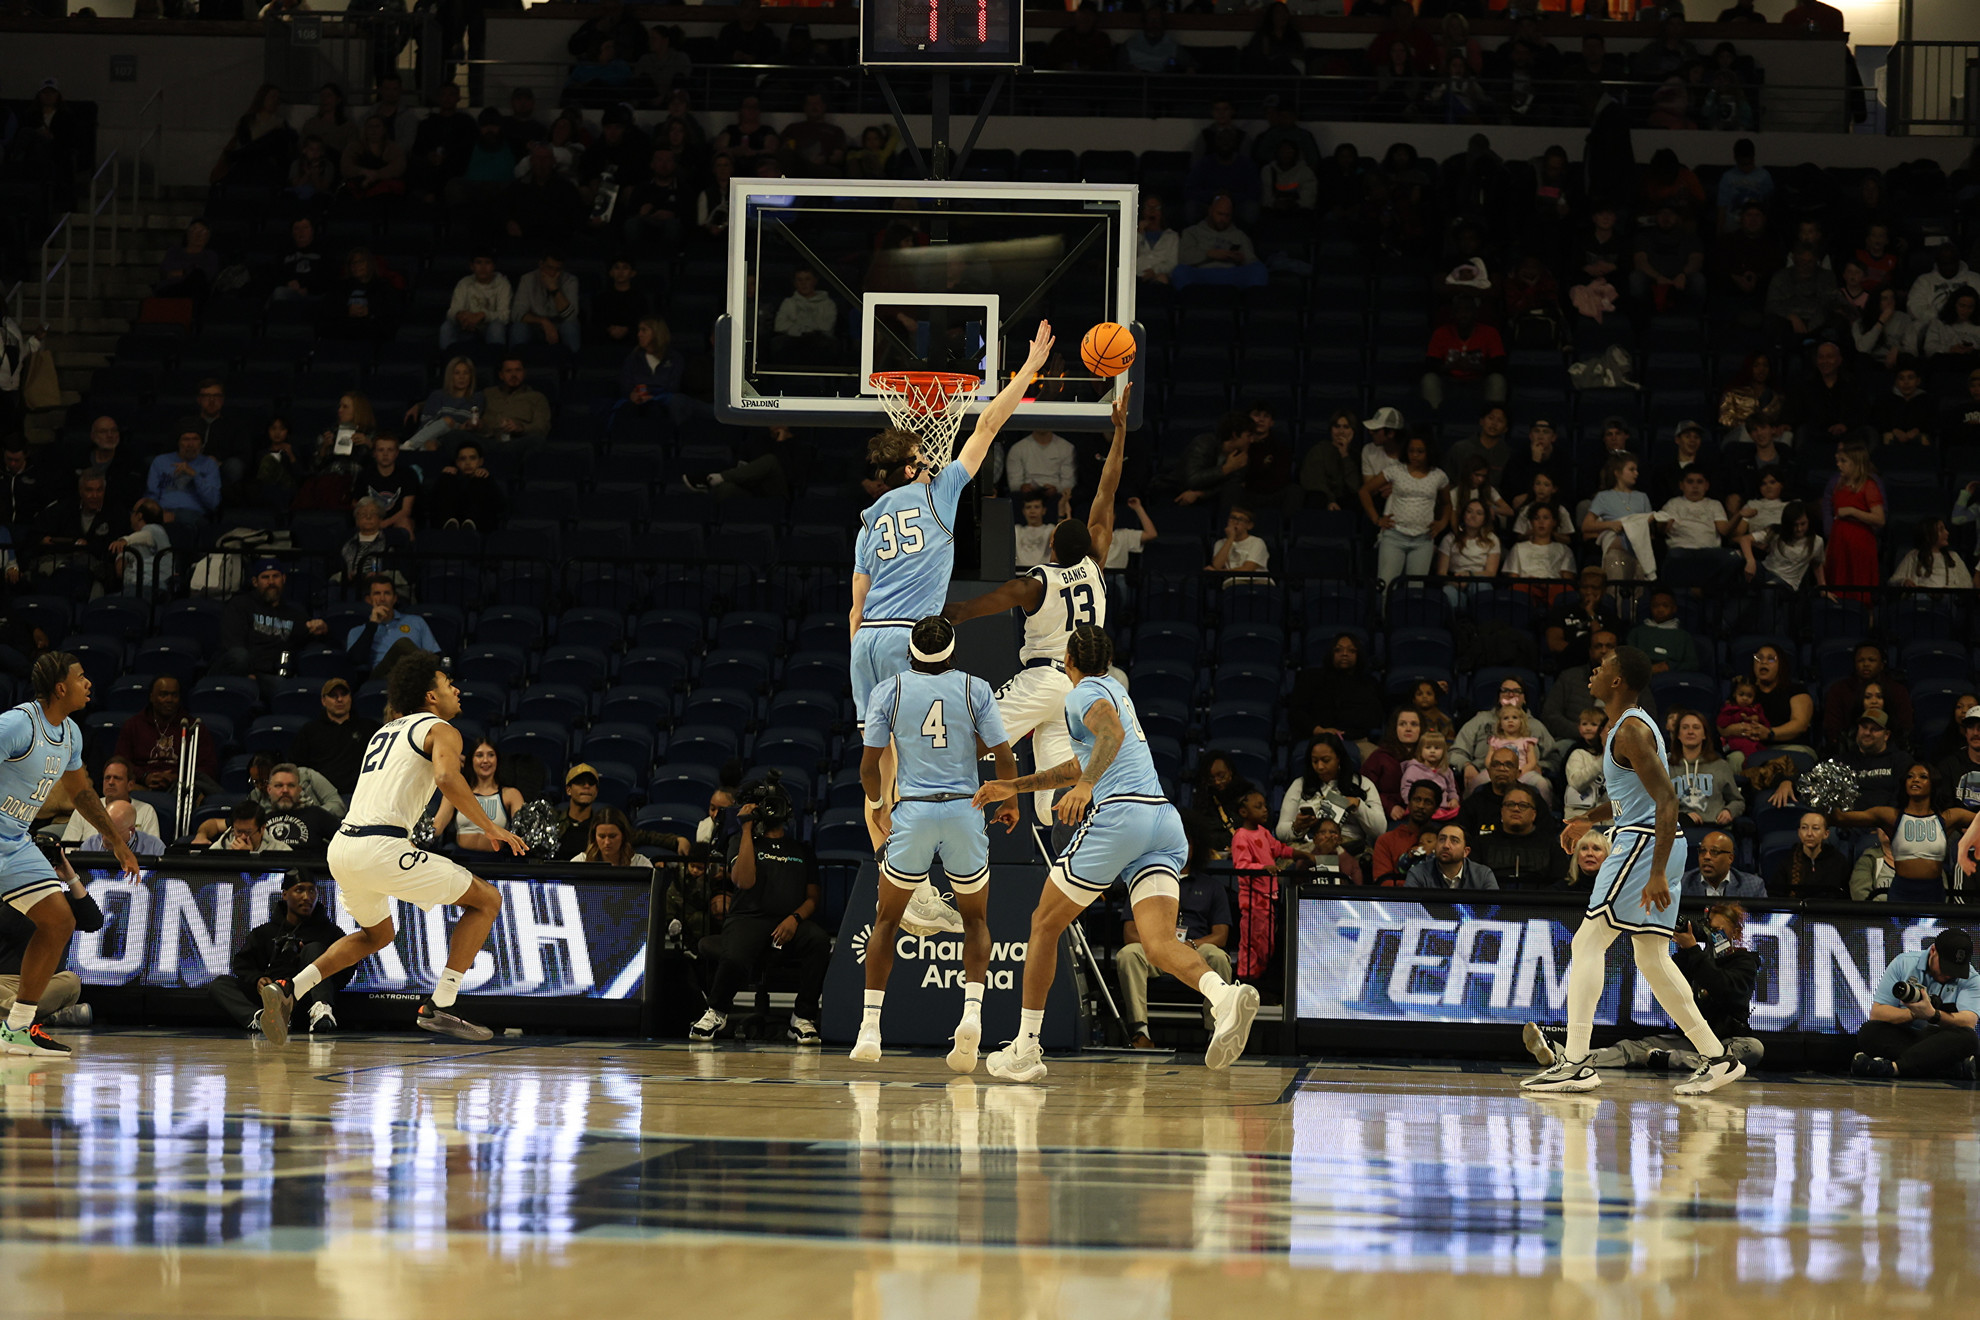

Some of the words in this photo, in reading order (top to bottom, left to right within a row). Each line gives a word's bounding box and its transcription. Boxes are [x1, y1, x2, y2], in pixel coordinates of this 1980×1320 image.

[741, 399, 780, 409] SPALDING
[873, 506, 925, 561] 35
[1061, 566, 1087, 585] BANKS
[1060, 583, 1097, 632] 13
[920, 699, 948, 748] 4
[362, 730, 400, 774] 21
[44, 756, 61, 775] OLD
[30, 777, 54, 802] 10
[1904, 820, 1937, 842] ODU
[896, 935, 1028, 962] Charwa
[1336, 918, 1573, 1009] TEAM
[368, 993, 421, 1001] DAKTRONICS
